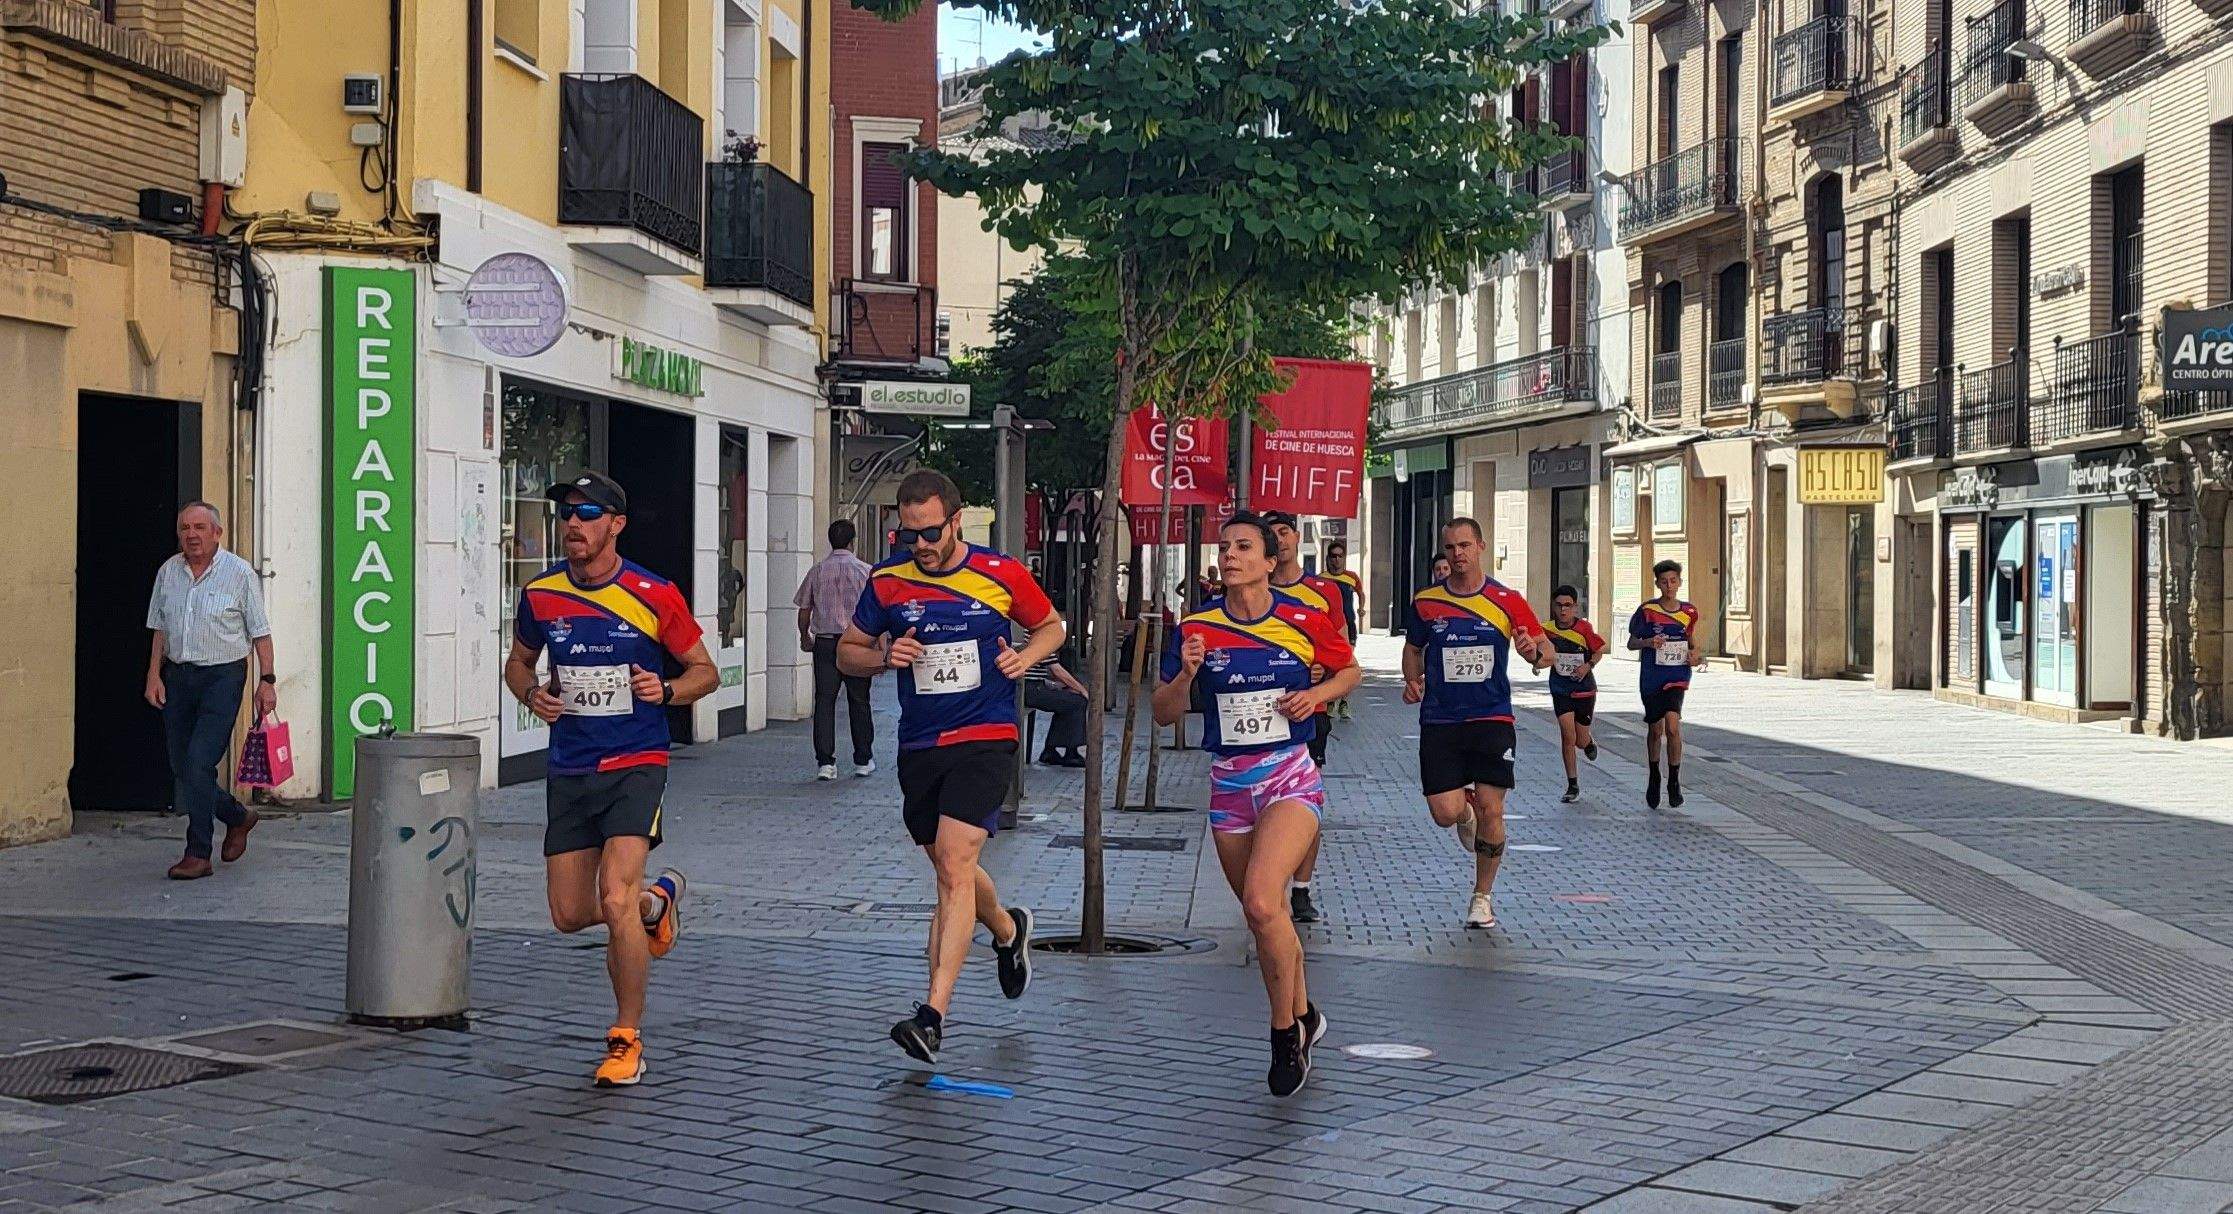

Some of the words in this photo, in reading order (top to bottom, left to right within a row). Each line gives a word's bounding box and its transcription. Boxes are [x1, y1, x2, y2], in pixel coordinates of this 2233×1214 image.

[2172, 369, 2208, 379] CENTRO
[1299, 429, 1356, 440] INTERNACIONAL
[1265, 439, 1278, 450] DE
[1280, 440, 1301, 452] CINE
[1302, 442, 1315, 453] DE
[1317, 443, 1355, 457] HUESCA
[1805, 452, 1878, 491] ASCASO
[1261, 463, 1354, 502] HIFF
[1135, 518, 1185, 538] HIF
[933, 667, 959, 684] 44
[1454, 664, 1484, 676] 279
[574, 691, 616, 707] 407
[1233, 716, 1273, 735] 497
